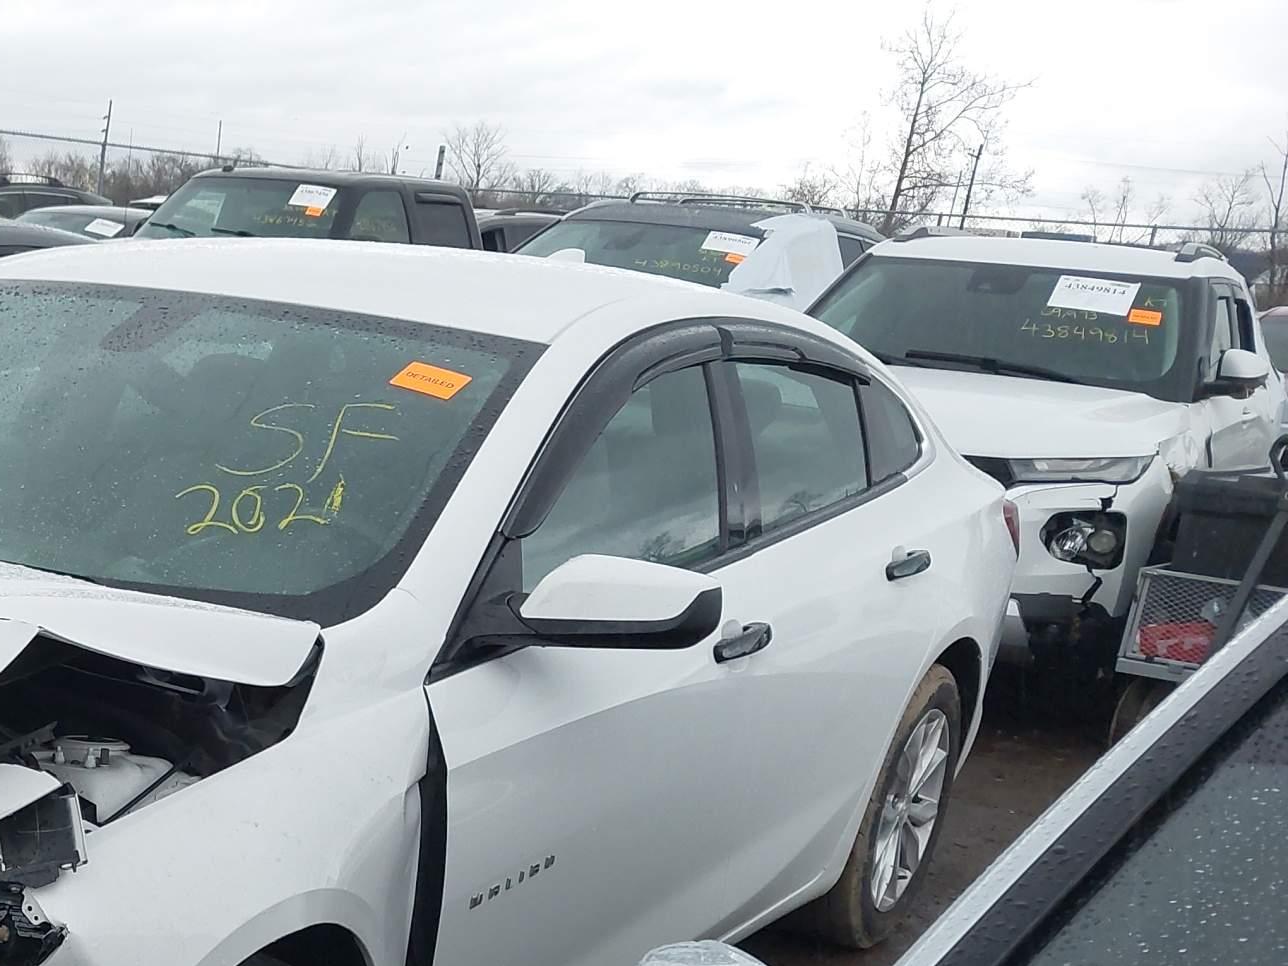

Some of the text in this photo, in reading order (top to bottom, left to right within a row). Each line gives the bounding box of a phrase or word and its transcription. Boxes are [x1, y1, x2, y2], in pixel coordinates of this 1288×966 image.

[1064, 283, 1127, 295] 43849814
[1020, 318, 1150, 345] 43849814
[406, 370, 455, 390] DETAILED
[215, 402, 399, 484] SF
